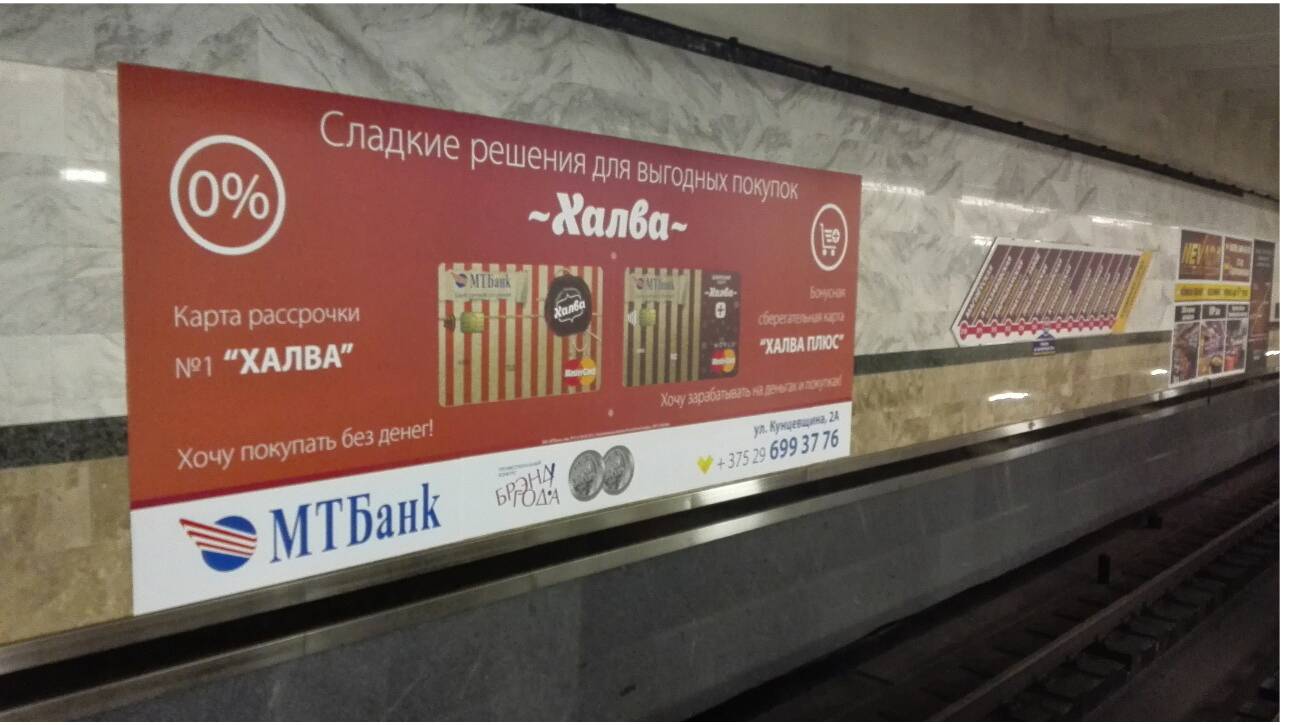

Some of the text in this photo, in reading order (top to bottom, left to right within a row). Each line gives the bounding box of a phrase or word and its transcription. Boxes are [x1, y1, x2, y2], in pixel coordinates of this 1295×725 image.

[320, 110, 799, 202] Сладкие решения для выгодных покупок
[188, 169, 270, 220] 0%
[173, 304, 360, 332] Карта рассрочки
[553, 299, 586, 320] Халва
[175, 343, 354, 379] №1 “ХАЛВА”
[660, 393, 686, 408] Хочу
[688, 387, 750, 406] зарабатывать
[752, 385, 764, 397] на
[177, 419, 434, 470] Хочу покупать без денег!
[754, 424, 768, 438] ул.
[769, 415, 828, 434] Кунцевщина,
[752, 447, 766, 465] 29
[769, 436, 797, 460] 699
[801, 433, 819, 454] 37
[823, 429, 839, 450] 76
